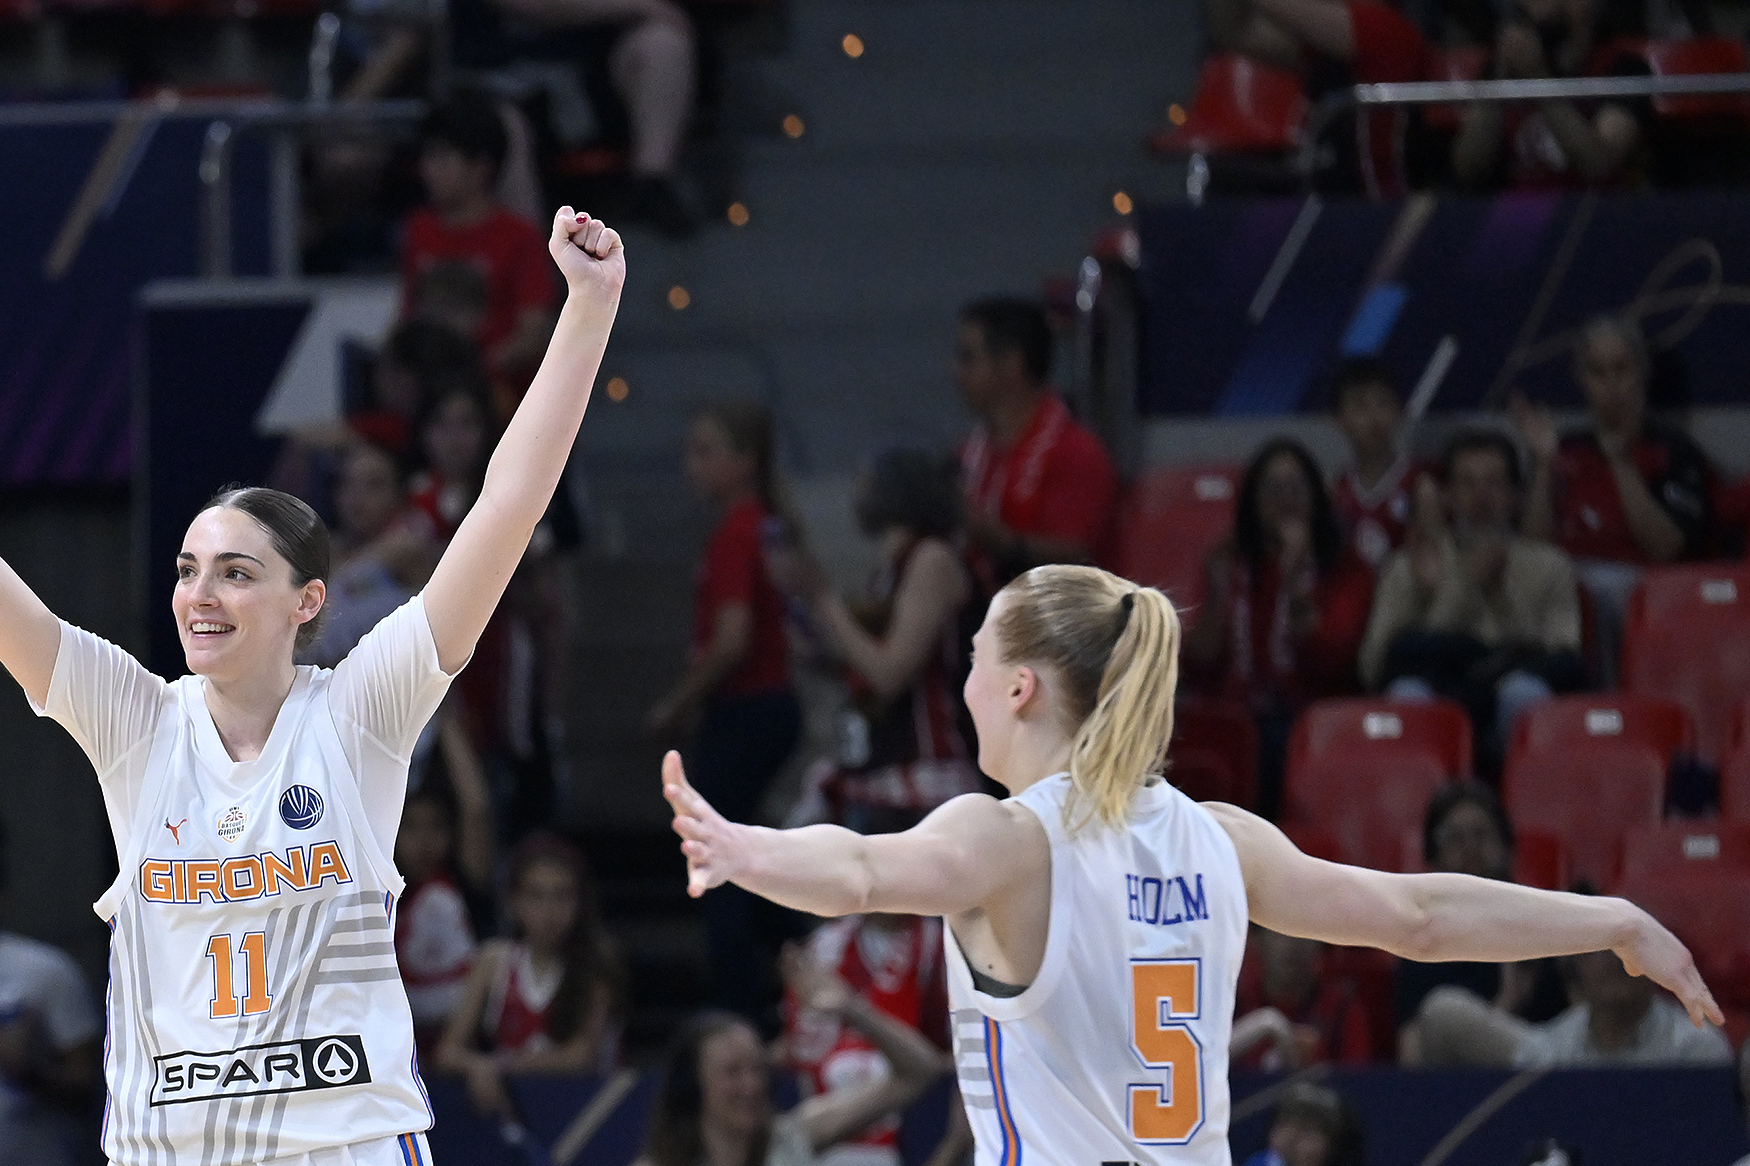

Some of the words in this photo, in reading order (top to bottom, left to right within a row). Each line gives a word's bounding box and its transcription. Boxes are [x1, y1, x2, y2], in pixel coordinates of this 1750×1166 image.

[140, 839, 354, 904] GIRONA
[1125, 873, 1210, 925] HOLM
[204, 931, 274, 1020] 11
[162, 1053, 301, 1094] SPAR
[1126, 957, 1206, 1146] 5
